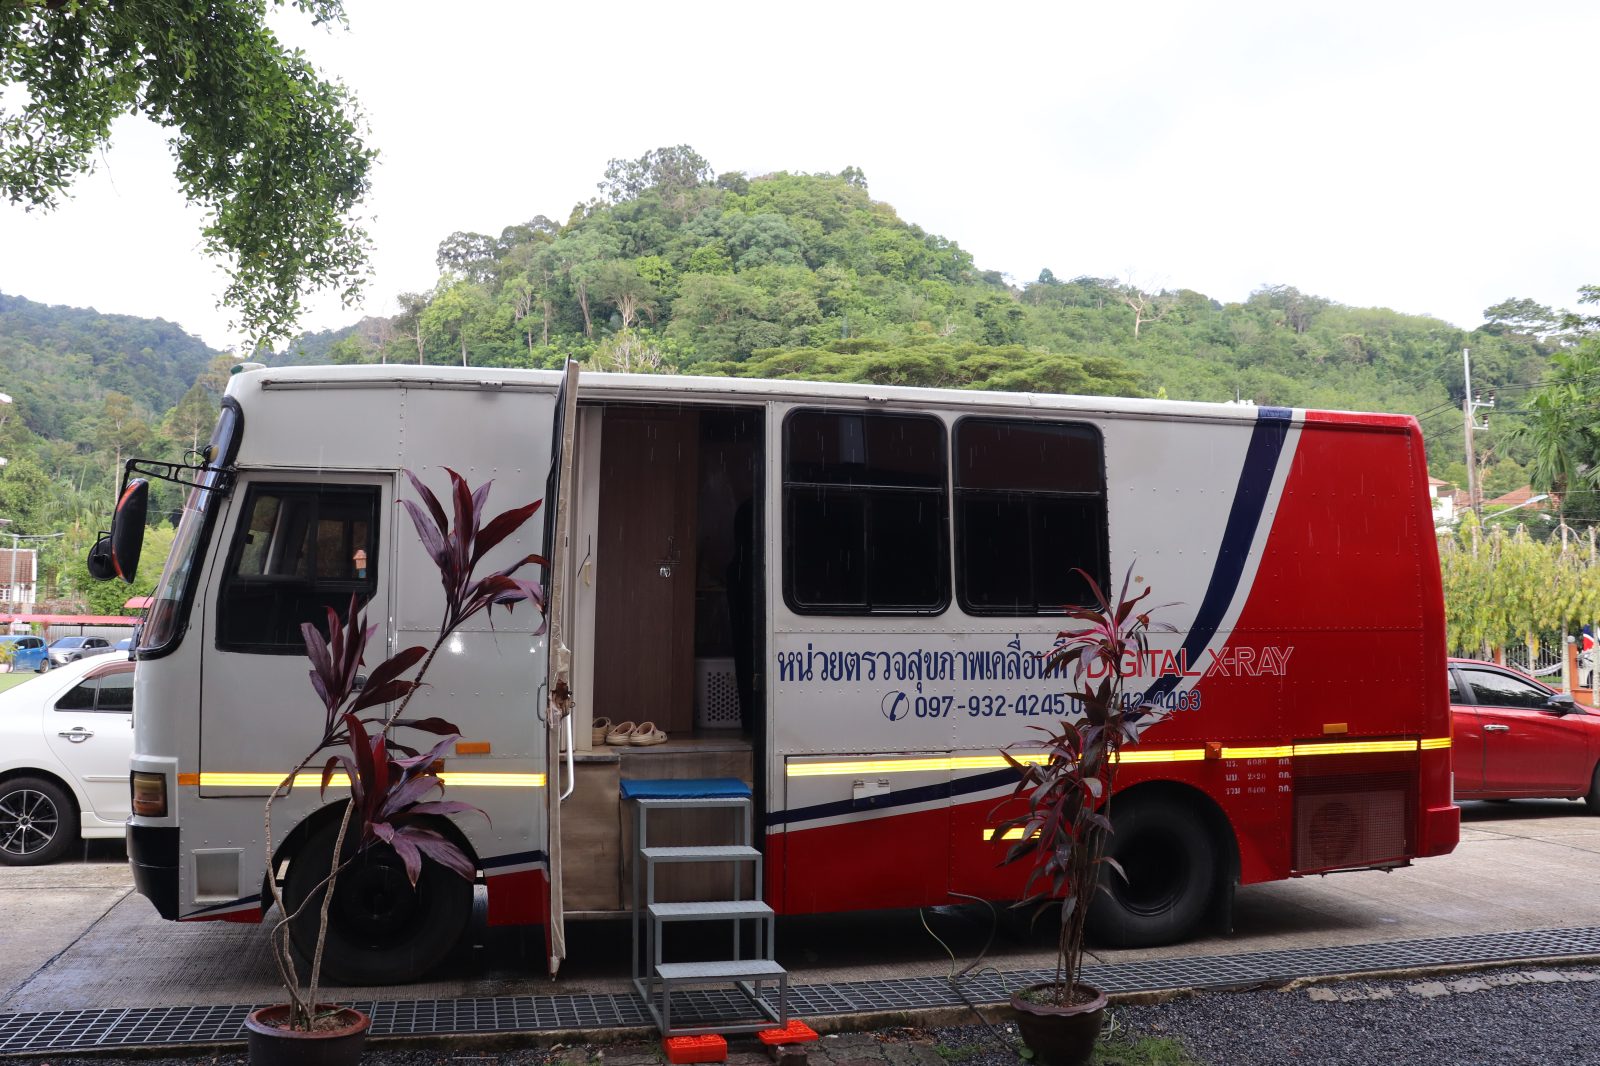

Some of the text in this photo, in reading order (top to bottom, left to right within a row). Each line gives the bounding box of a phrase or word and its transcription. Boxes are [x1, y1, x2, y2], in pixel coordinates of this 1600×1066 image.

[777, 633, 1068, 694] หน่วยตรวจสุขภาพเคลื่อนที
[1086, 645, 1294, 678] DIGITAL X-RAY
